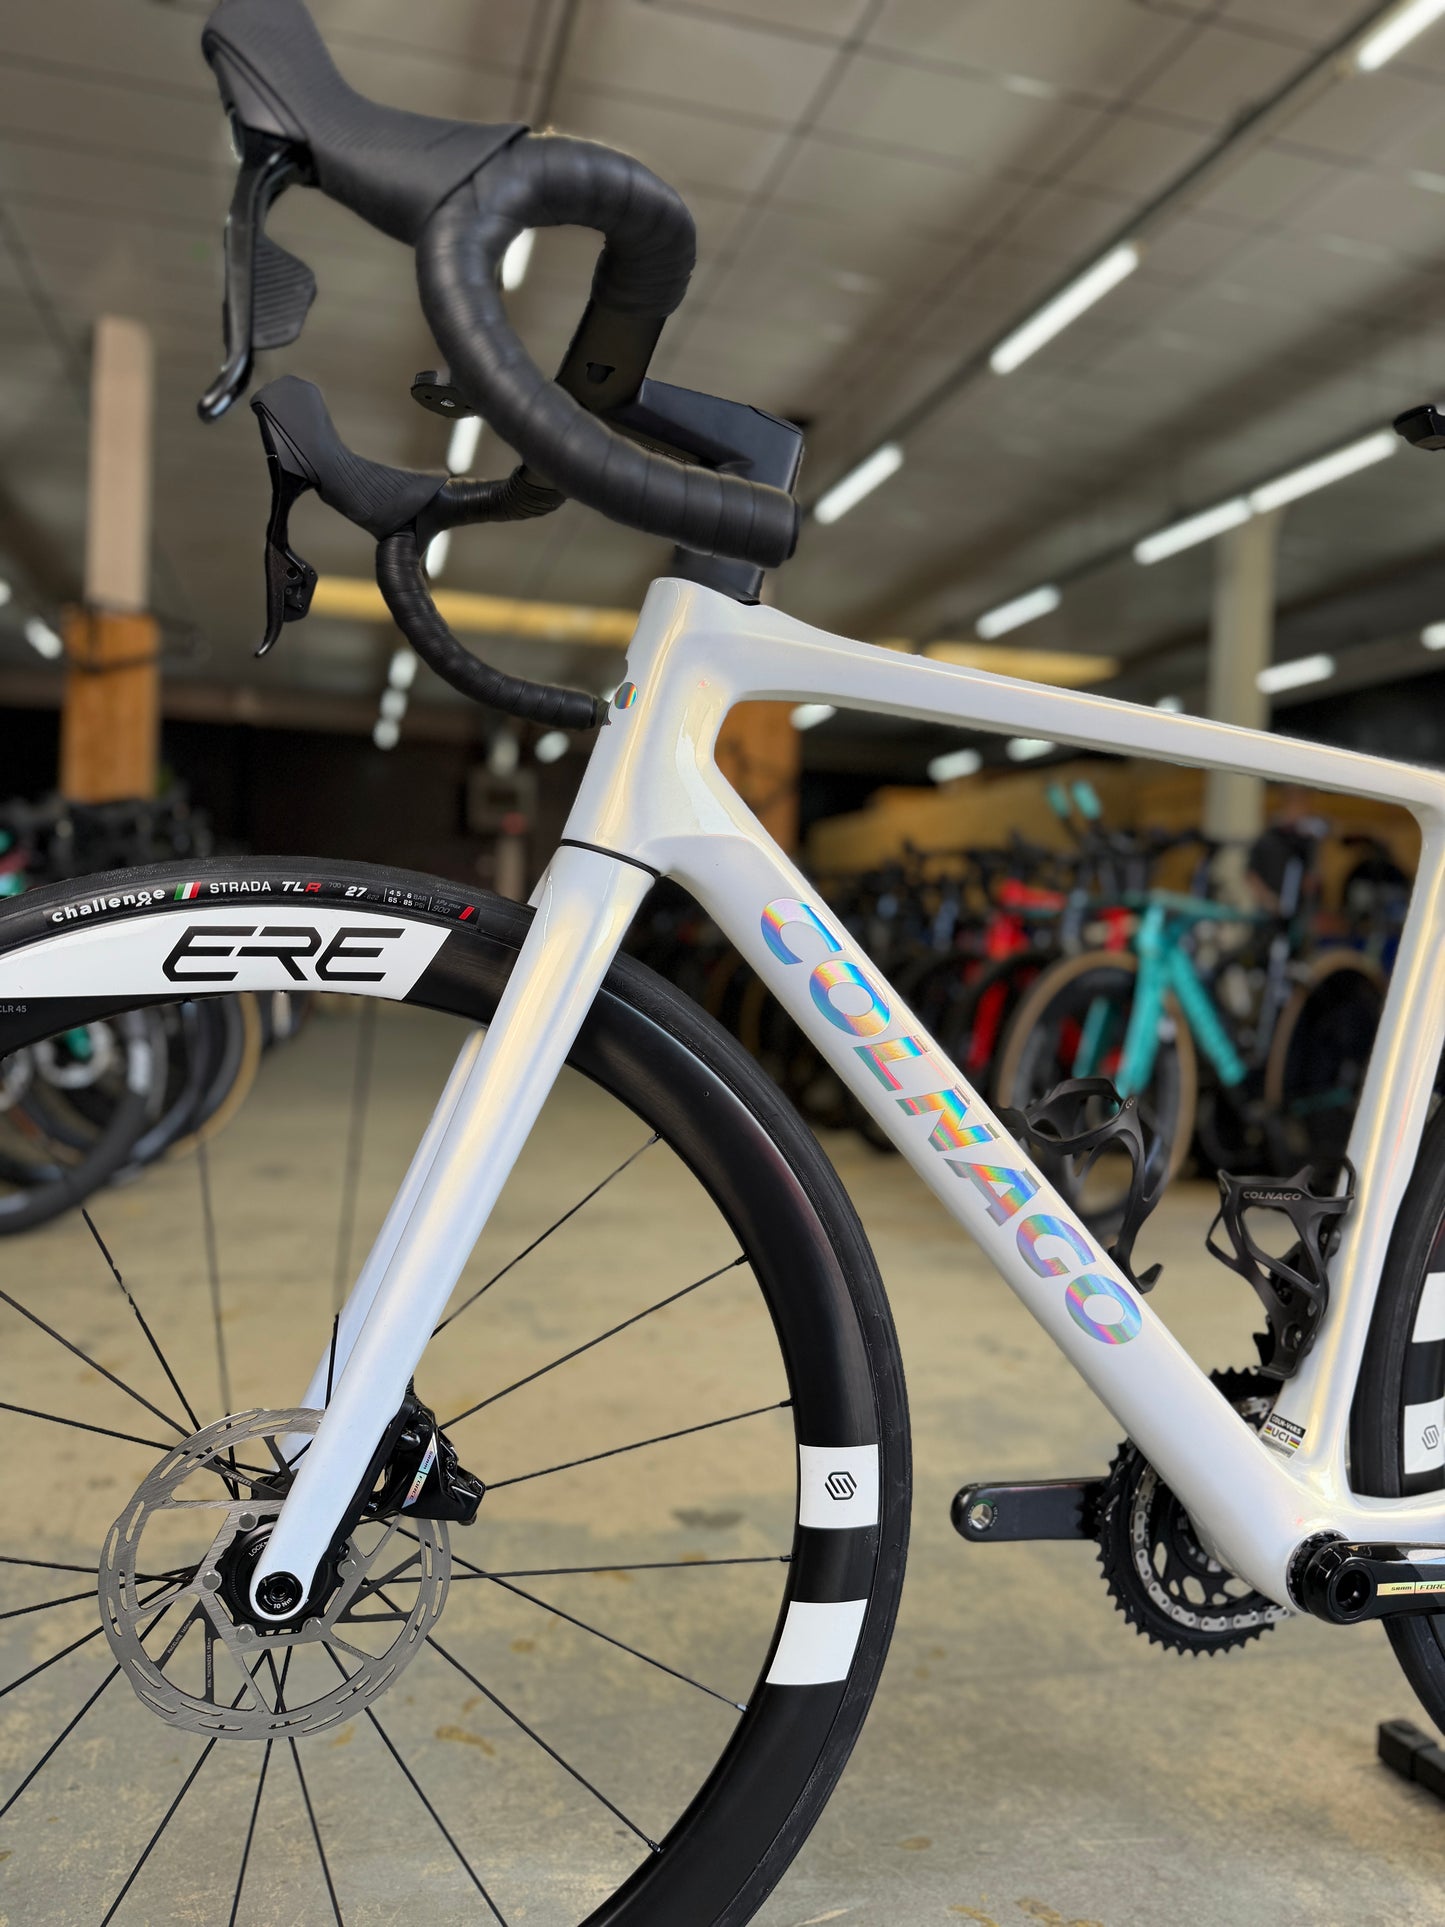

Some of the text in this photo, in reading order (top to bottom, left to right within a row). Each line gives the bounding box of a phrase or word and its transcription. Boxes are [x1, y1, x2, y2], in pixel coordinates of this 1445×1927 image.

[51, 889, 166, 923] challenge
[209, 881, 272, 894] STRADA
[281, 881, 322, 893] TLR
[344, 885, 368, 898] 27
[162, 925, 406, 982] ERE
[15, 1004, 27, 1013] 45
[760, 898, 1143, 1345] COLNAGO
[1243, 1191, 1302, 1201] COLNAGO
[1271, 1427, 1290, 1444] UCI
[248, 1542, 265, 1557] LOCK
